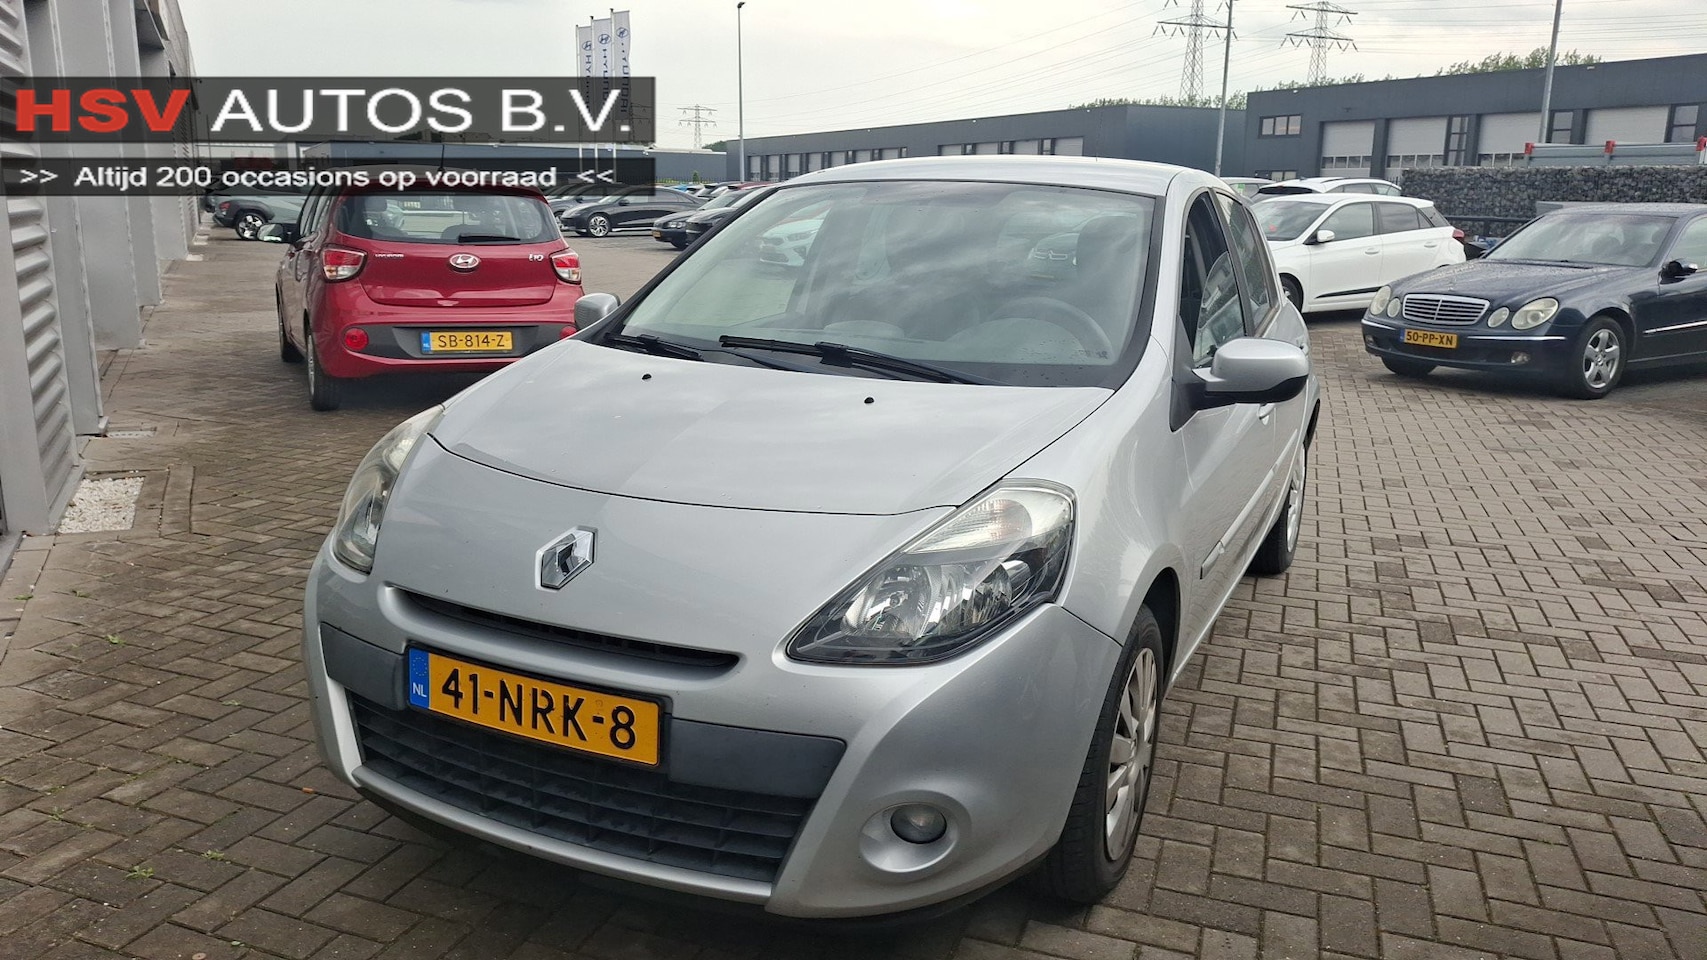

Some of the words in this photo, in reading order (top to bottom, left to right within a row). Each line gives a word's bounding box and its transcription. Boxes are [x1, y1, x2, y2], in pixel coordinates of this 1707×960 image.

[438, 334, 505, 348] SB-814-Z
[1406, 331, 1454, 346] 50-PP-XN
[412, 682, 427, 698] NL
[441, 668, 636, 750] 41-NRK-8
